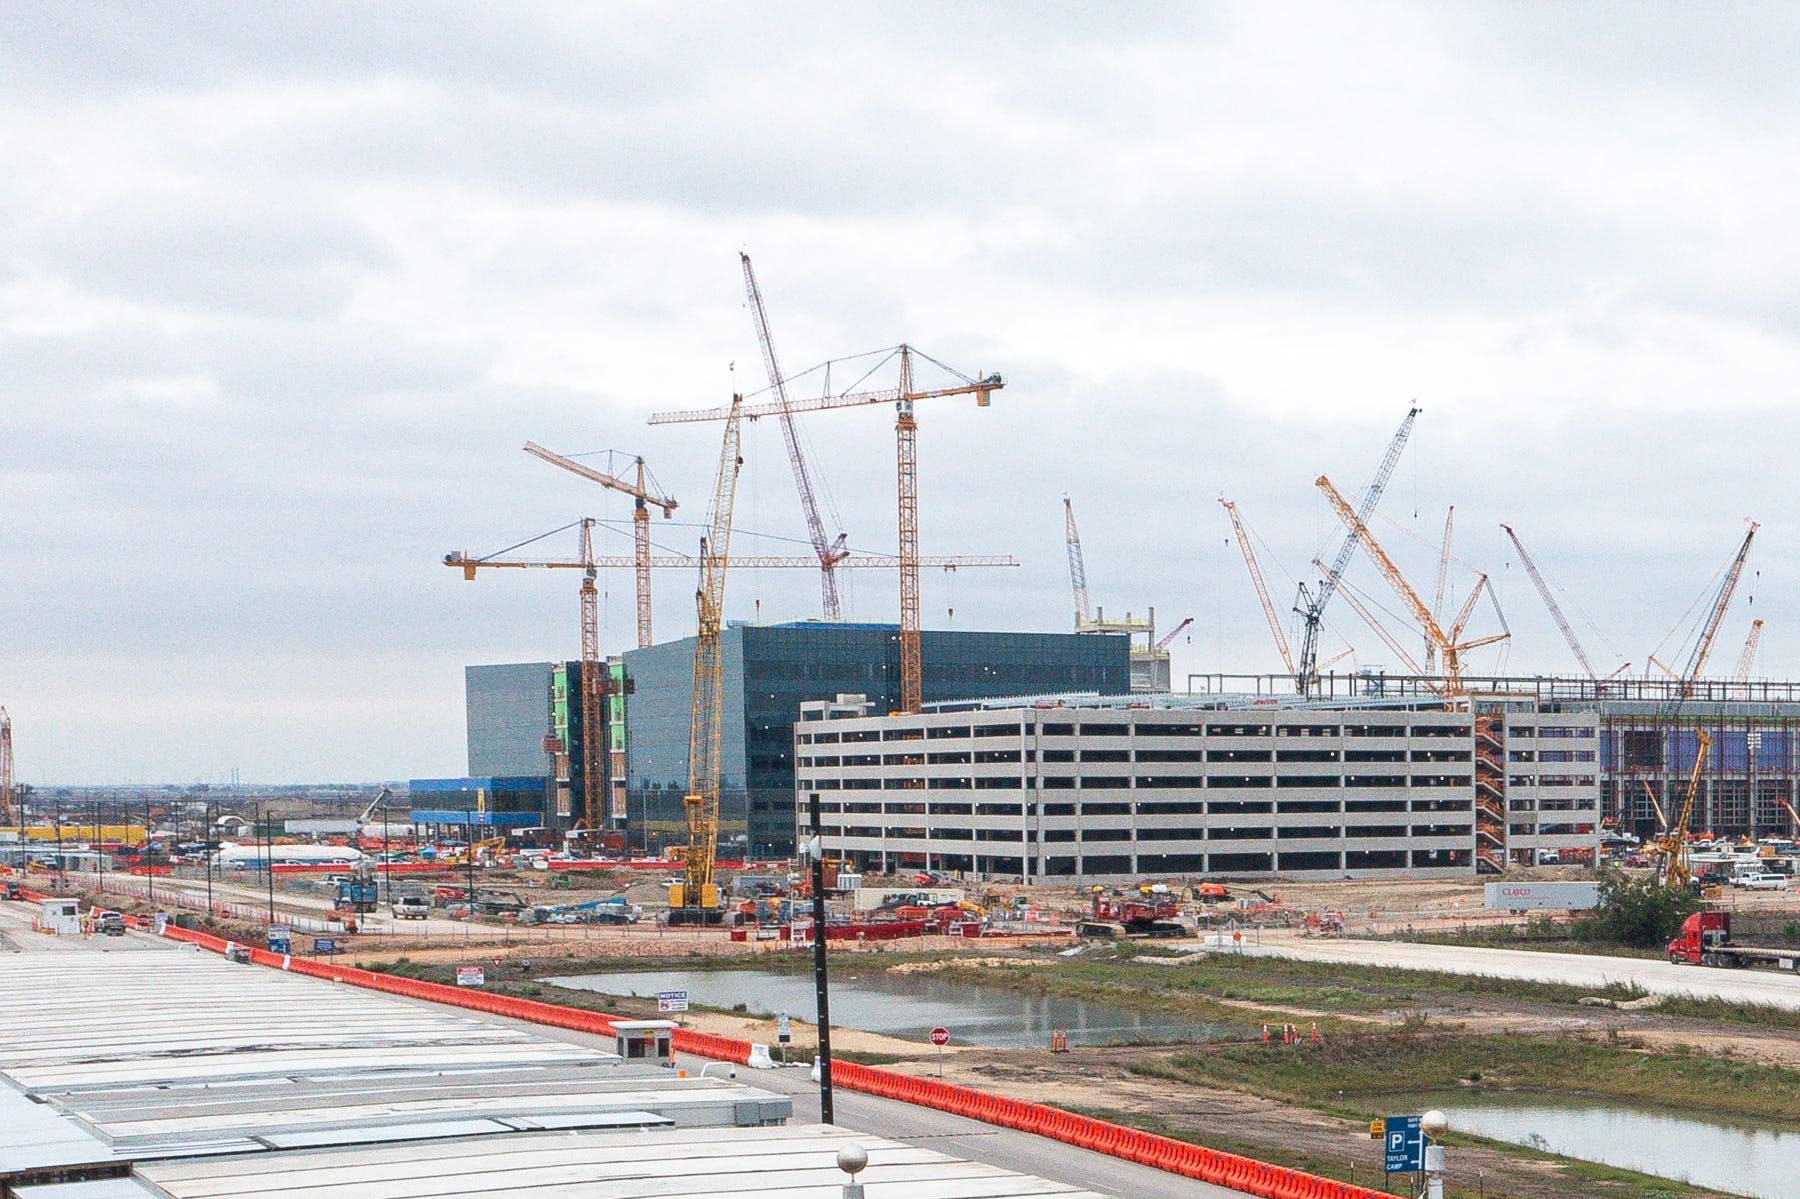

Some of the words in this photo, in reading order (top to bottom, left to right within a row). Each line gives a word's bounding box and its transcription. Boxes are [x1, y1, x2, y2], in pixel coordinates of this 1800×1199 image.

[931, 1033, 949, 1041] STOP
[1391, 1134, 1403, 1149] P
[1387, 1154, 1408, 1162] TAYLOR
